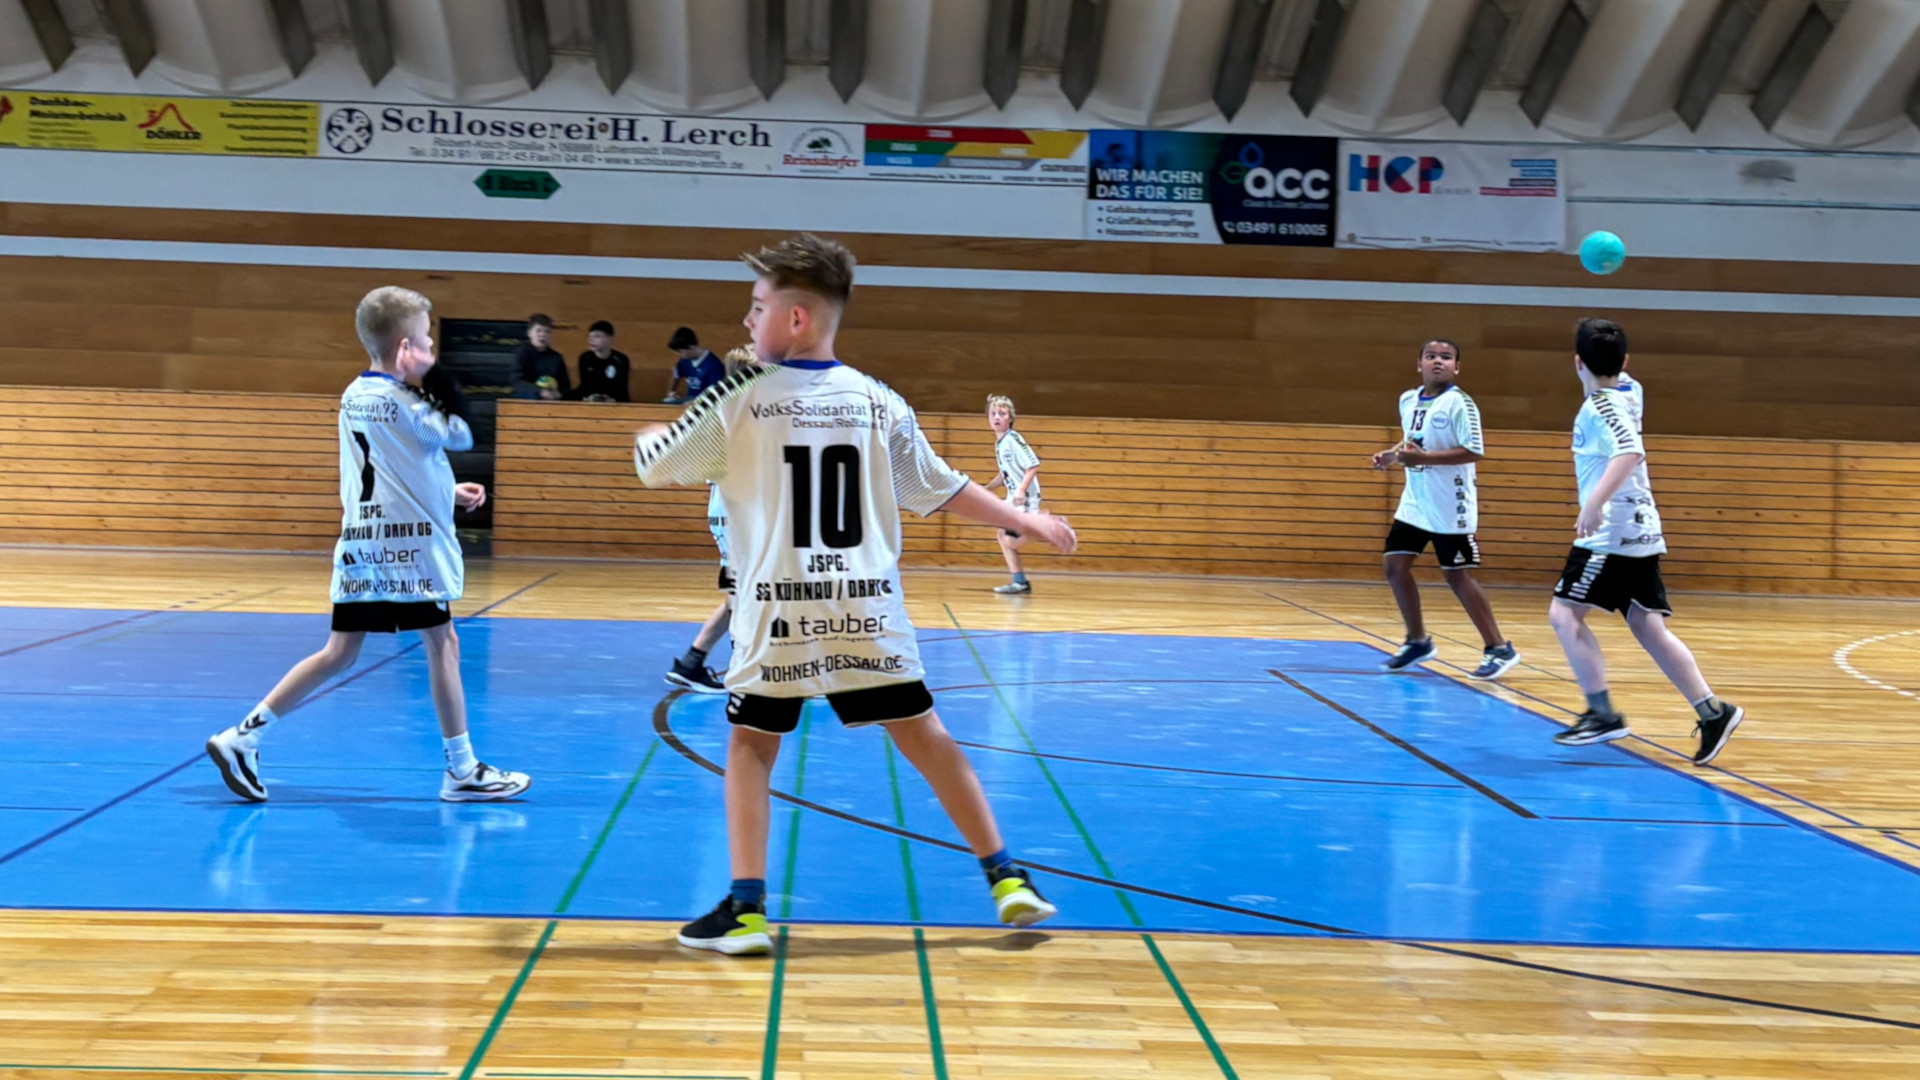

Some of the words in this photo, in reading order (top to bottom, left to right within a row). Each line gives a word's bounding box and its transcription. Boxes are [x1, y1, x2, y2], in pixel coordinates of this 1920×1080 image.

[381, 108, 596, 141] Schlosserei
[610, 117, 649, 142] H.
[661, 119, 772, 147] Lerch
[1096, 168, 1128, 182] WIR
[1132, 169, 1203, 184] MACHEN
[1244, 167, 1330, 199] acc
[1348, 154, 1443, 194] HCP
[1096, 184, 1130, 198] DAS
[1135, 185, 1167, 200] FÜR
[1173, 186, 1203, 200] SIE!
[1410, 409, 1427, 431] 13
[783, 444, 863, 549] 10
[358, 547, 420, 564] tauber
[807, 554, 849, 573] JSPG.
[775, 578, 833, 601] KÜHNAU
[798, 613, 888, 636] tauber
